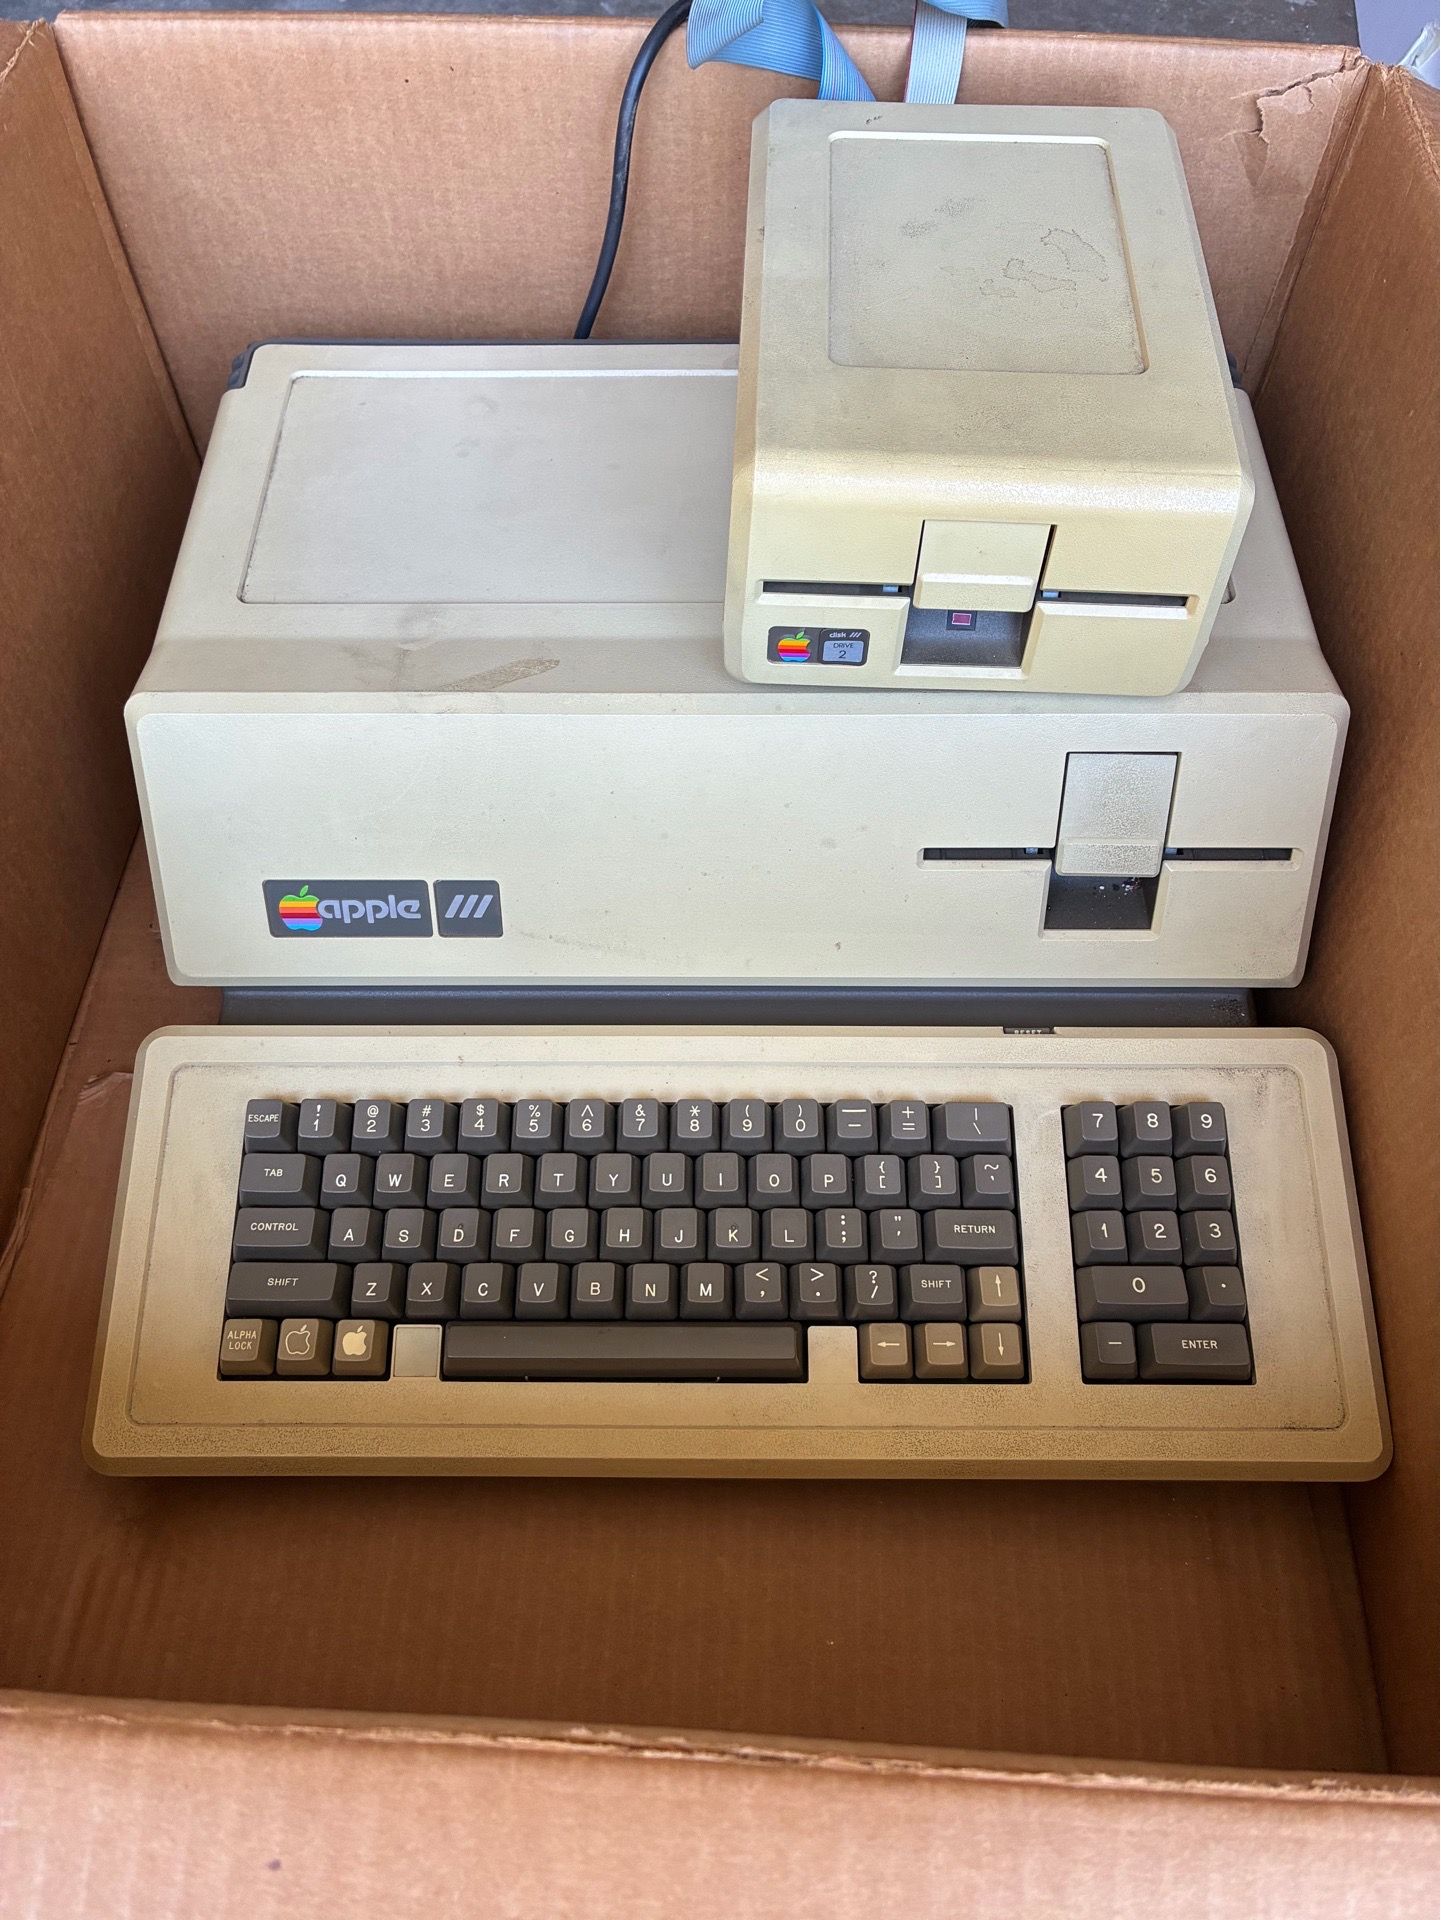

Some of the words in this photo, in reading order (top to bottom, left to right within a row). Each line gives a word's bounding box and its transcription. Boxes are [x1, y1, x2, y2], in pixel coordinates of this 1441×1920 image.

[838, 650, 847, 659] 2
[317, 895, 422, 923] apple
[367, 1105, 378, 1117] @
[422, 1105, 431, 1116] #
[477, 1104, 484, 1116] $
[529, 1105, 540, 1117] %
[636, 1104, 645, 1116] &
[902, 1107, 914, 1118] +
[248, 1114, 278, 1122] ESCAPE
[1093, 1114, 1103, 1128] 7
[1147, 1113, 1158, 1127] 8
[1201, 1114, 1212, 1128] 9
[367, 1120, 376, 1132] 2
[421, 1119, 430, 1131] 3
[475, 1119, 484, 1130] 4
[529, 1119, 538, 1132] 5
[582, 1119, 591, 1131] 6
[636, 1119, 645, 1131] 7
[690, 1119, 699, 1131] 8
[743, 1119, 752, 1131] 9
[878, 1161, 886, 1173] {
[933, 1161, 941, 1173] }
[336, 1174, 346, 1187] Q
[389, 1174, 402, 1186] W
[444, 1174, 454, 1187] E
[499, 1174, 509, 1186] R
[554, 1174, 563, 1186] T
[609, 1174, 618, 1186] Y
[663, 1174, 672, 1186] U
[769, 1174, 779, 1187] O
[825, 1175, 833, 1187] P
[1095, 1168, 1107, 1182] 4
[1152, 1169, 1162, 1183] 5
[1205, 1169, 1216, 1182] 6
[934, 1176, 942, 1188] ]
[344, 1229, 353, 1241] A
[954, 1225, 995, 1233] RETURN
[1154, 1224, 1166, 1238] 2
[1210, 1223, 1221, 1238] 3
[399, 1230, 408, 1242] S
[454, 1229, 464, 1242] D
[510, 1229, 520, 1242] F
[565, 1230, 574, 1242] G
[620, 1229, 629, 1242] H
[675, 1230, 683, 1242] J
[729, 1230, 738, 1241] K
[785, 1230, 794, 1242] L
[756, 1269, 768, 1281] <
[811, 1268, 823, 1281] >
[869, 1271, 877, 1283] ?
[268, 1278, 298, 1286] SHIFT
[921, 1280, 951, 1288] SHIFT
[366, 1283, 376, 1295] Z
[422, 1283, 432, 1295] X
[478, 1283, 488, 1296] C
[534, 1283, 544, 1296] V
[591, 1282, 600, 1295] B
[646, 1284, 655, 1296] N
[700, 1283, 711, 1296] M
[871, 1286, 878, 1298] /
[228, 1331, 256, 1339] ALPHA
[229, 1342, 252, 1350] LOCK
[1182, 1340, 1217, 1349] ENTER
